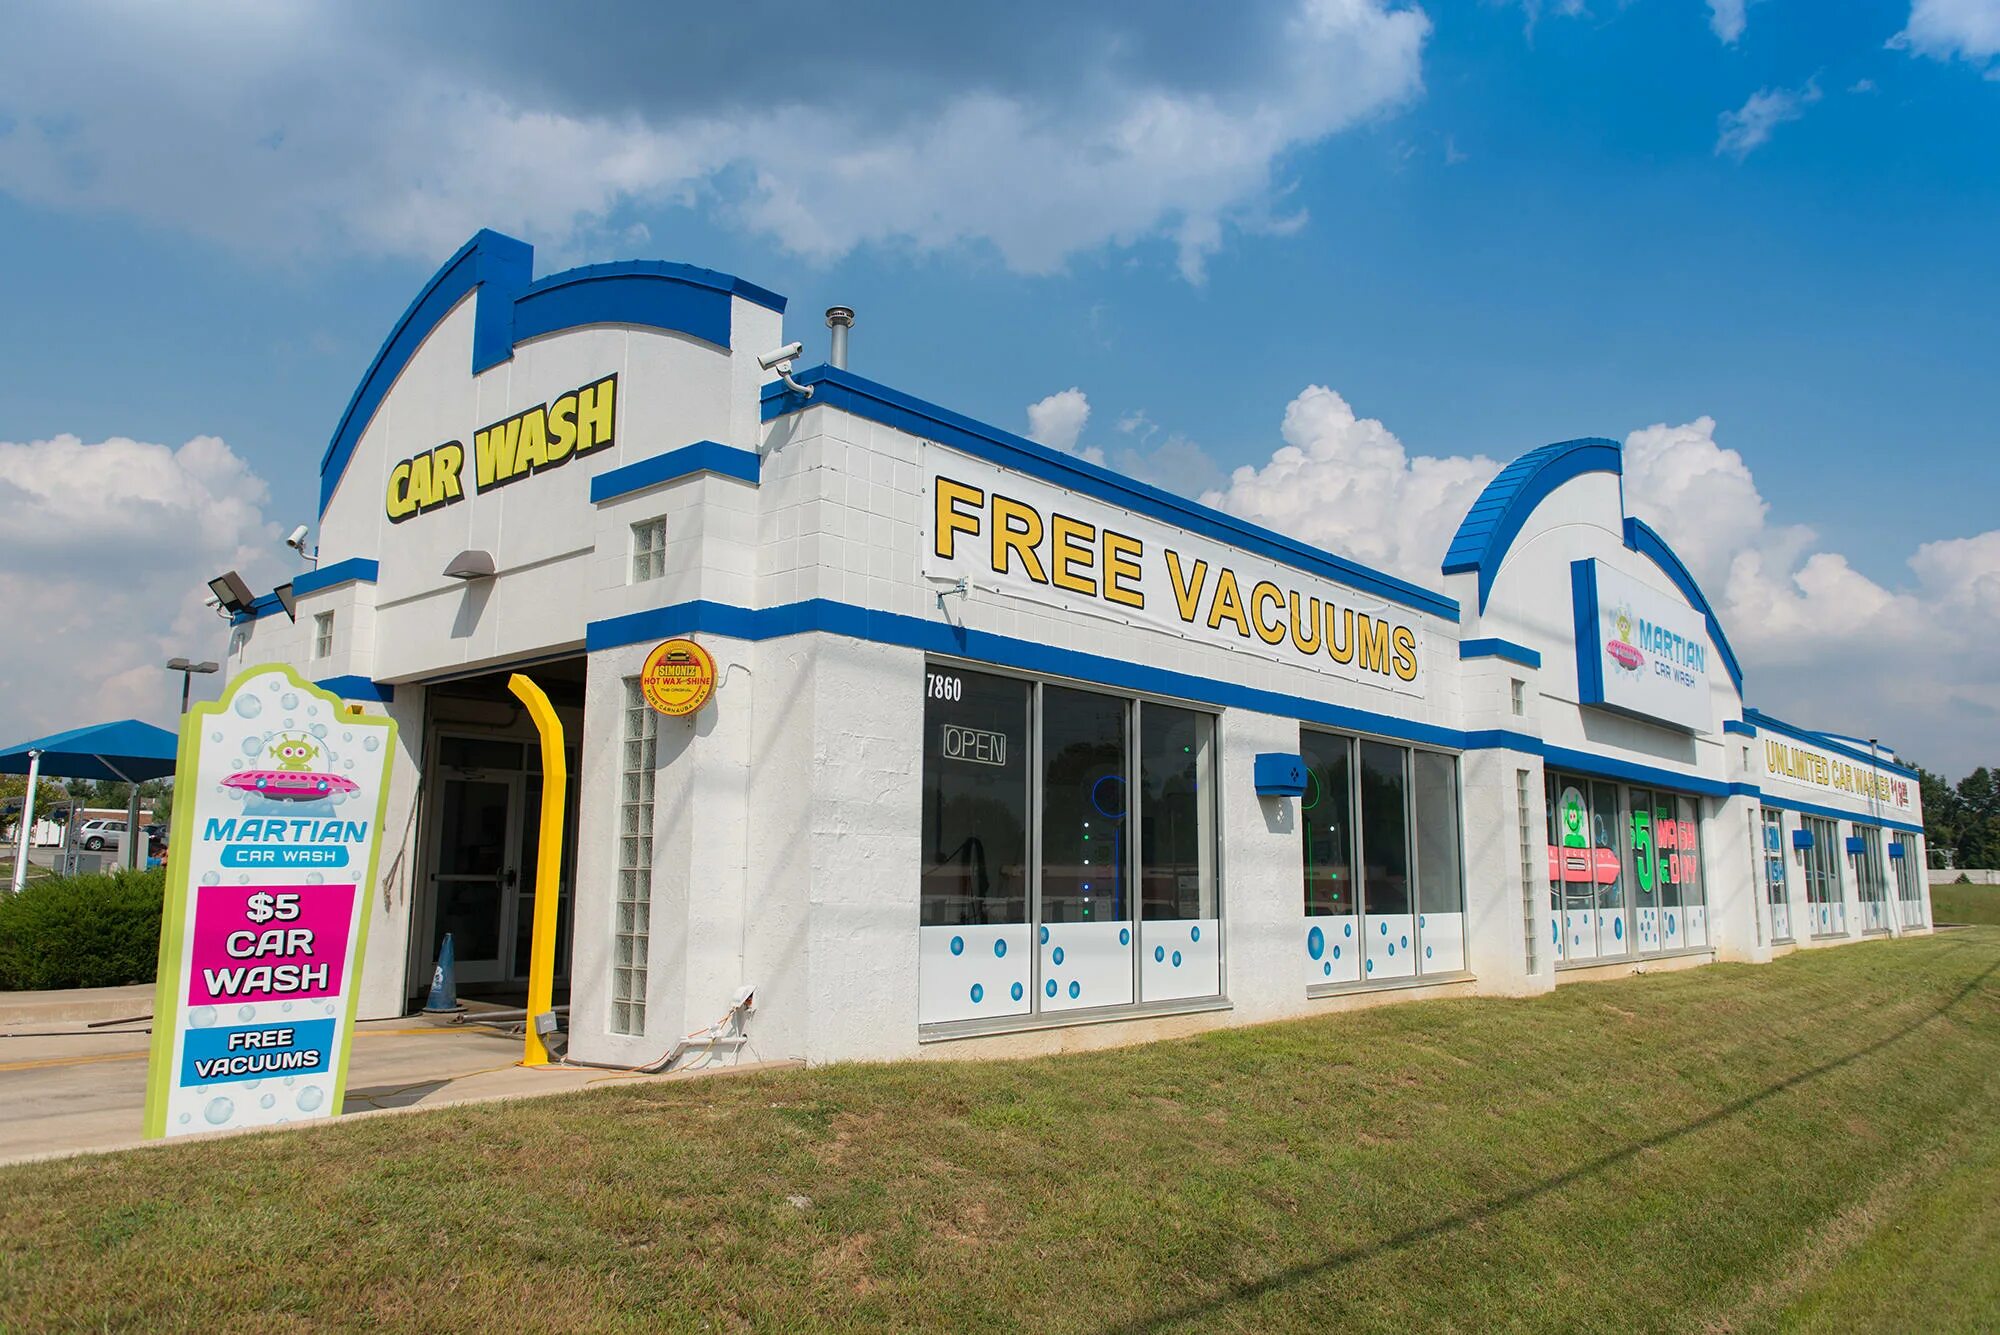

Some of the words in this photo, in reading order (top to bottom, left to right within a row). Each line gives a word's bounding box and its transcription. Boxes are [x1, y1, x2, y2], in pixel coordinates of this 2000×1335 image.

[386, 440, 464, 524] CAR
[474, 372, 618, 495] WASH
[934, 476, 1145, 610] FREE
[1164, 549, 1418, 682] VACUUMS
[1639, 618, 1705, 674] MARTIAN
[644, 677, 661, 685] HOT
[663, 677, 681, 685] WAX
[686, 677, 711, 685] SHINE
[659, 665, 696, 677] SIMONIZ
[1654, 661, 1671, 680] CAR
[1673, 669, 1696, 688] WASH
[927, 673, 962, 701] 7860
[947, 729, 1003, 762] OPEN
[1765, 739, 1829, 786] UNLIMITED
[1831, 759, 1854, 793] CAR
[203, 818, 368, 843] MARTIAN
[1656, 819, 1696, 850] WASH
[236, 851, 275, 862] CAR
[283, 850, 336, 862] WASH
[246, 891, 301, 924] $5
[226, 928, 314, 958] CAR
[203, 963, 330, 997] WASH
[228, 1028, 294, 1051] FREE
[194, 1050, 320, 1078] VACUUMS
